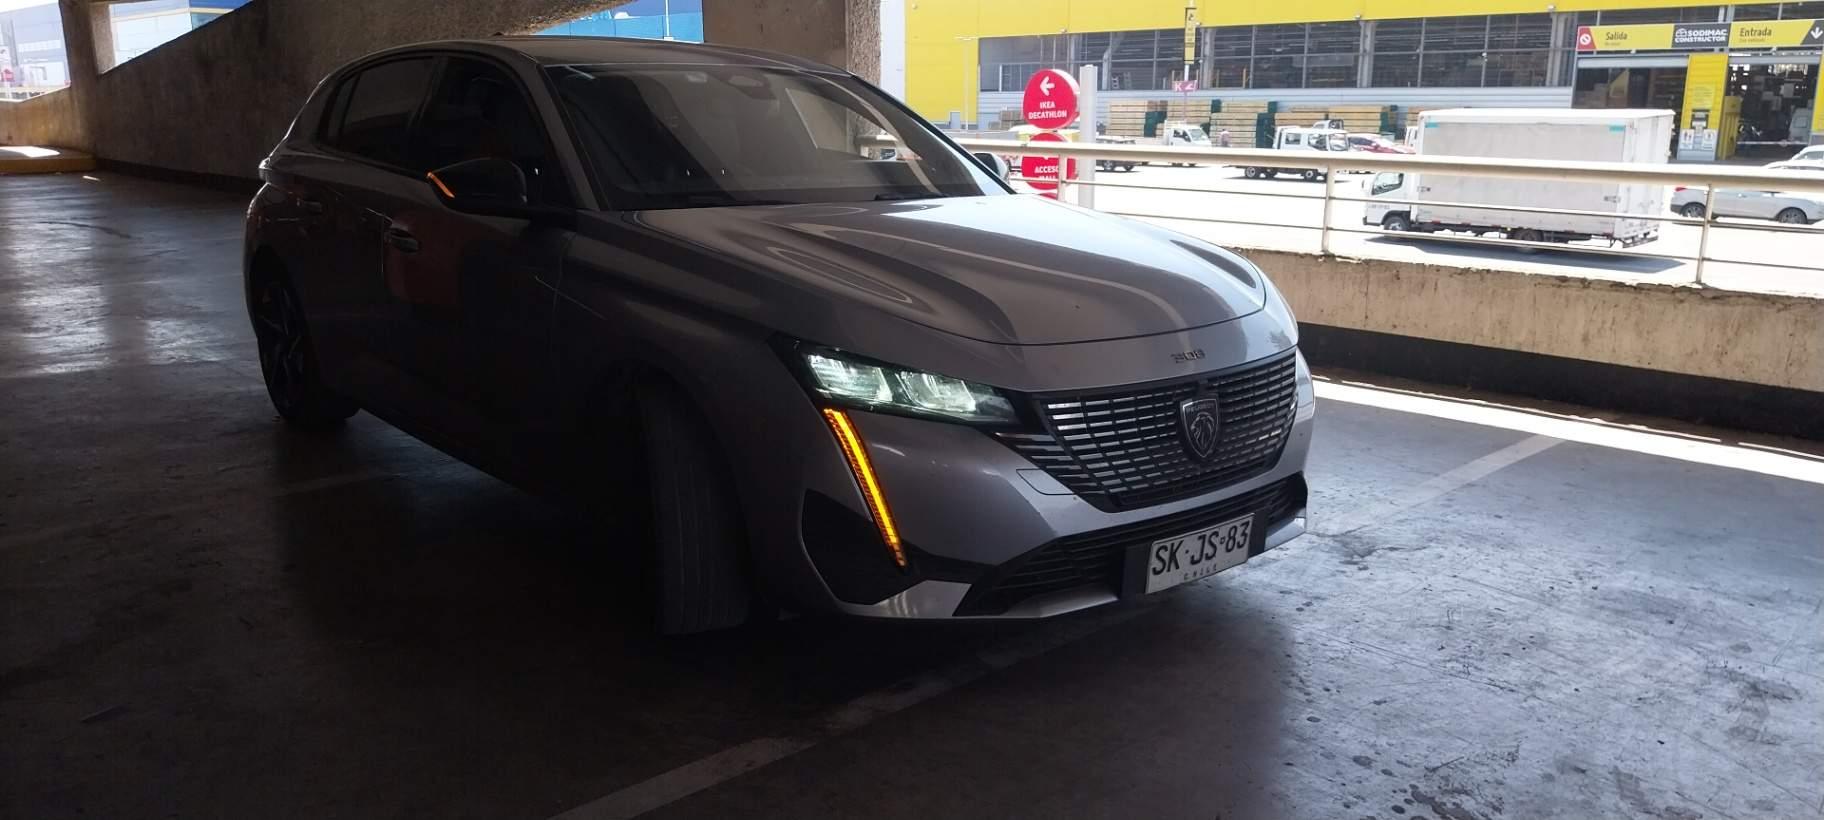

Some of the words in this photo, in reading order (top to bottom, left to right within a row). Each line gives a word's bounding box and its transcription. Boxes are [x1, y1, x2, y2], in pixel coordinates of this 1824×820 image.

[1605, 31, 1628, 41] Salida
[1687, 28, 1727, 37] SODIMAC
[1739, 26, 1772, 37] Entrada
[1039, 101, 1056, 109] IKEA
[1028, 110, 1067, 119] DECATHLON
